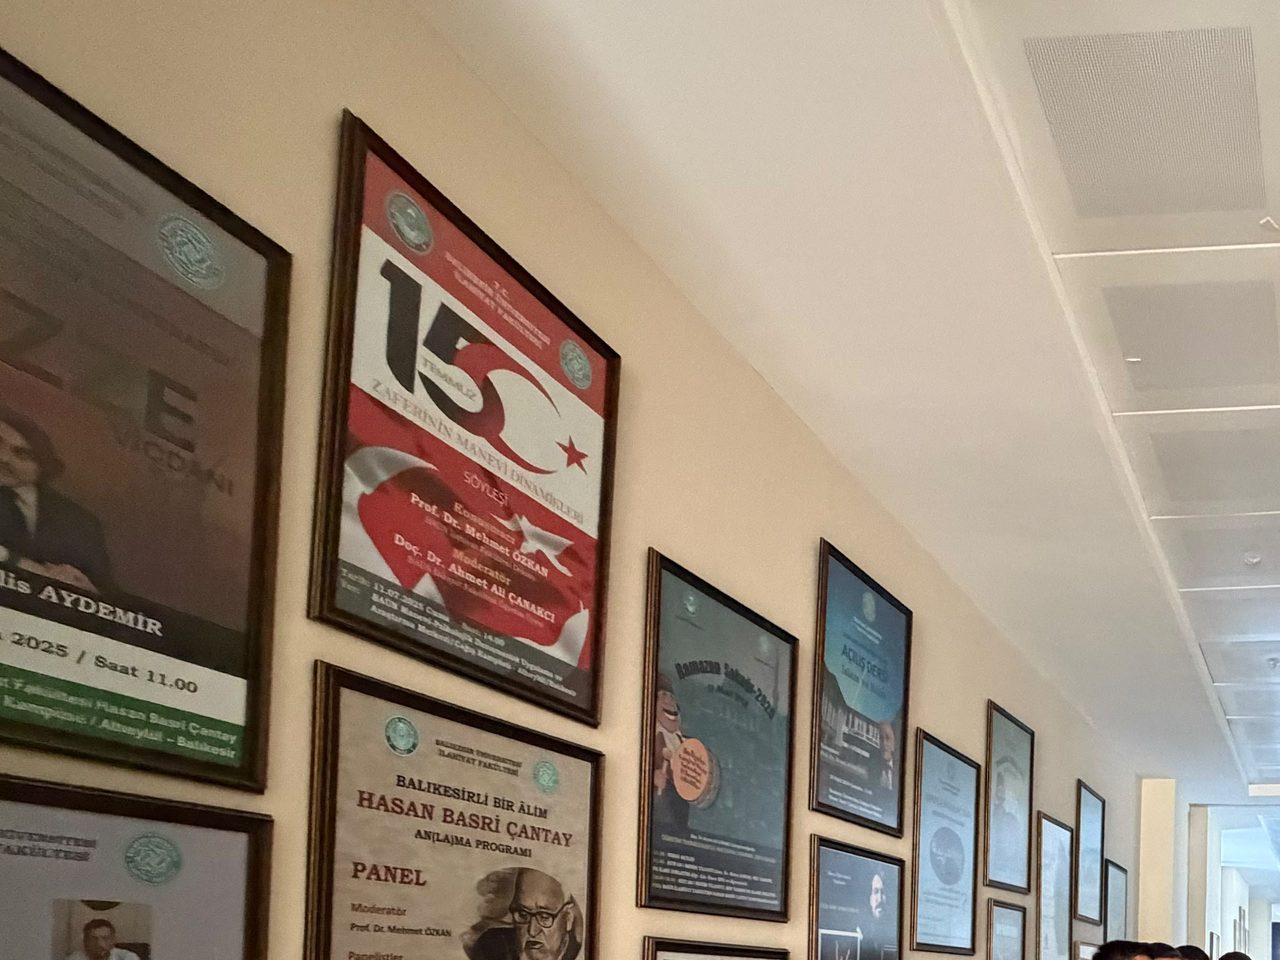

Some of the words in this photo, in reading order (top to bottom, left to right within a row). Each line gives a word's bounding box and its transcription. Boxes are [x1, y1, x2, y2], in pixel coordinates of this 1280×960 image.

[463, 470, 509, 508] SÖYLEŞİ
[410, 491, 440, 519] Prof.
[465, 522, 510, 558] Mehmet
[448, 560, 488, 591] Ahmet
[38, 585, 164, 637] AYDEMİR
[12, 632, 68, 658] 2025
[94, 655, 139, 678] Saat
[147, 670, 198, 694] 11.00
[357, 790, 436, 821] HASAN
[442, 807, 501, 834] BASRİ
[507, 821, 572, 848] ÇANTAY
[396, 774, 488, 806] BALIKESİRLİ
[493, 796, 515, 812] BİR
[518, 799, 548, 819] ÂLİM
[475, 840, 532, 858] PROGRAMI
[351, 861, 427, 886] PANEL
